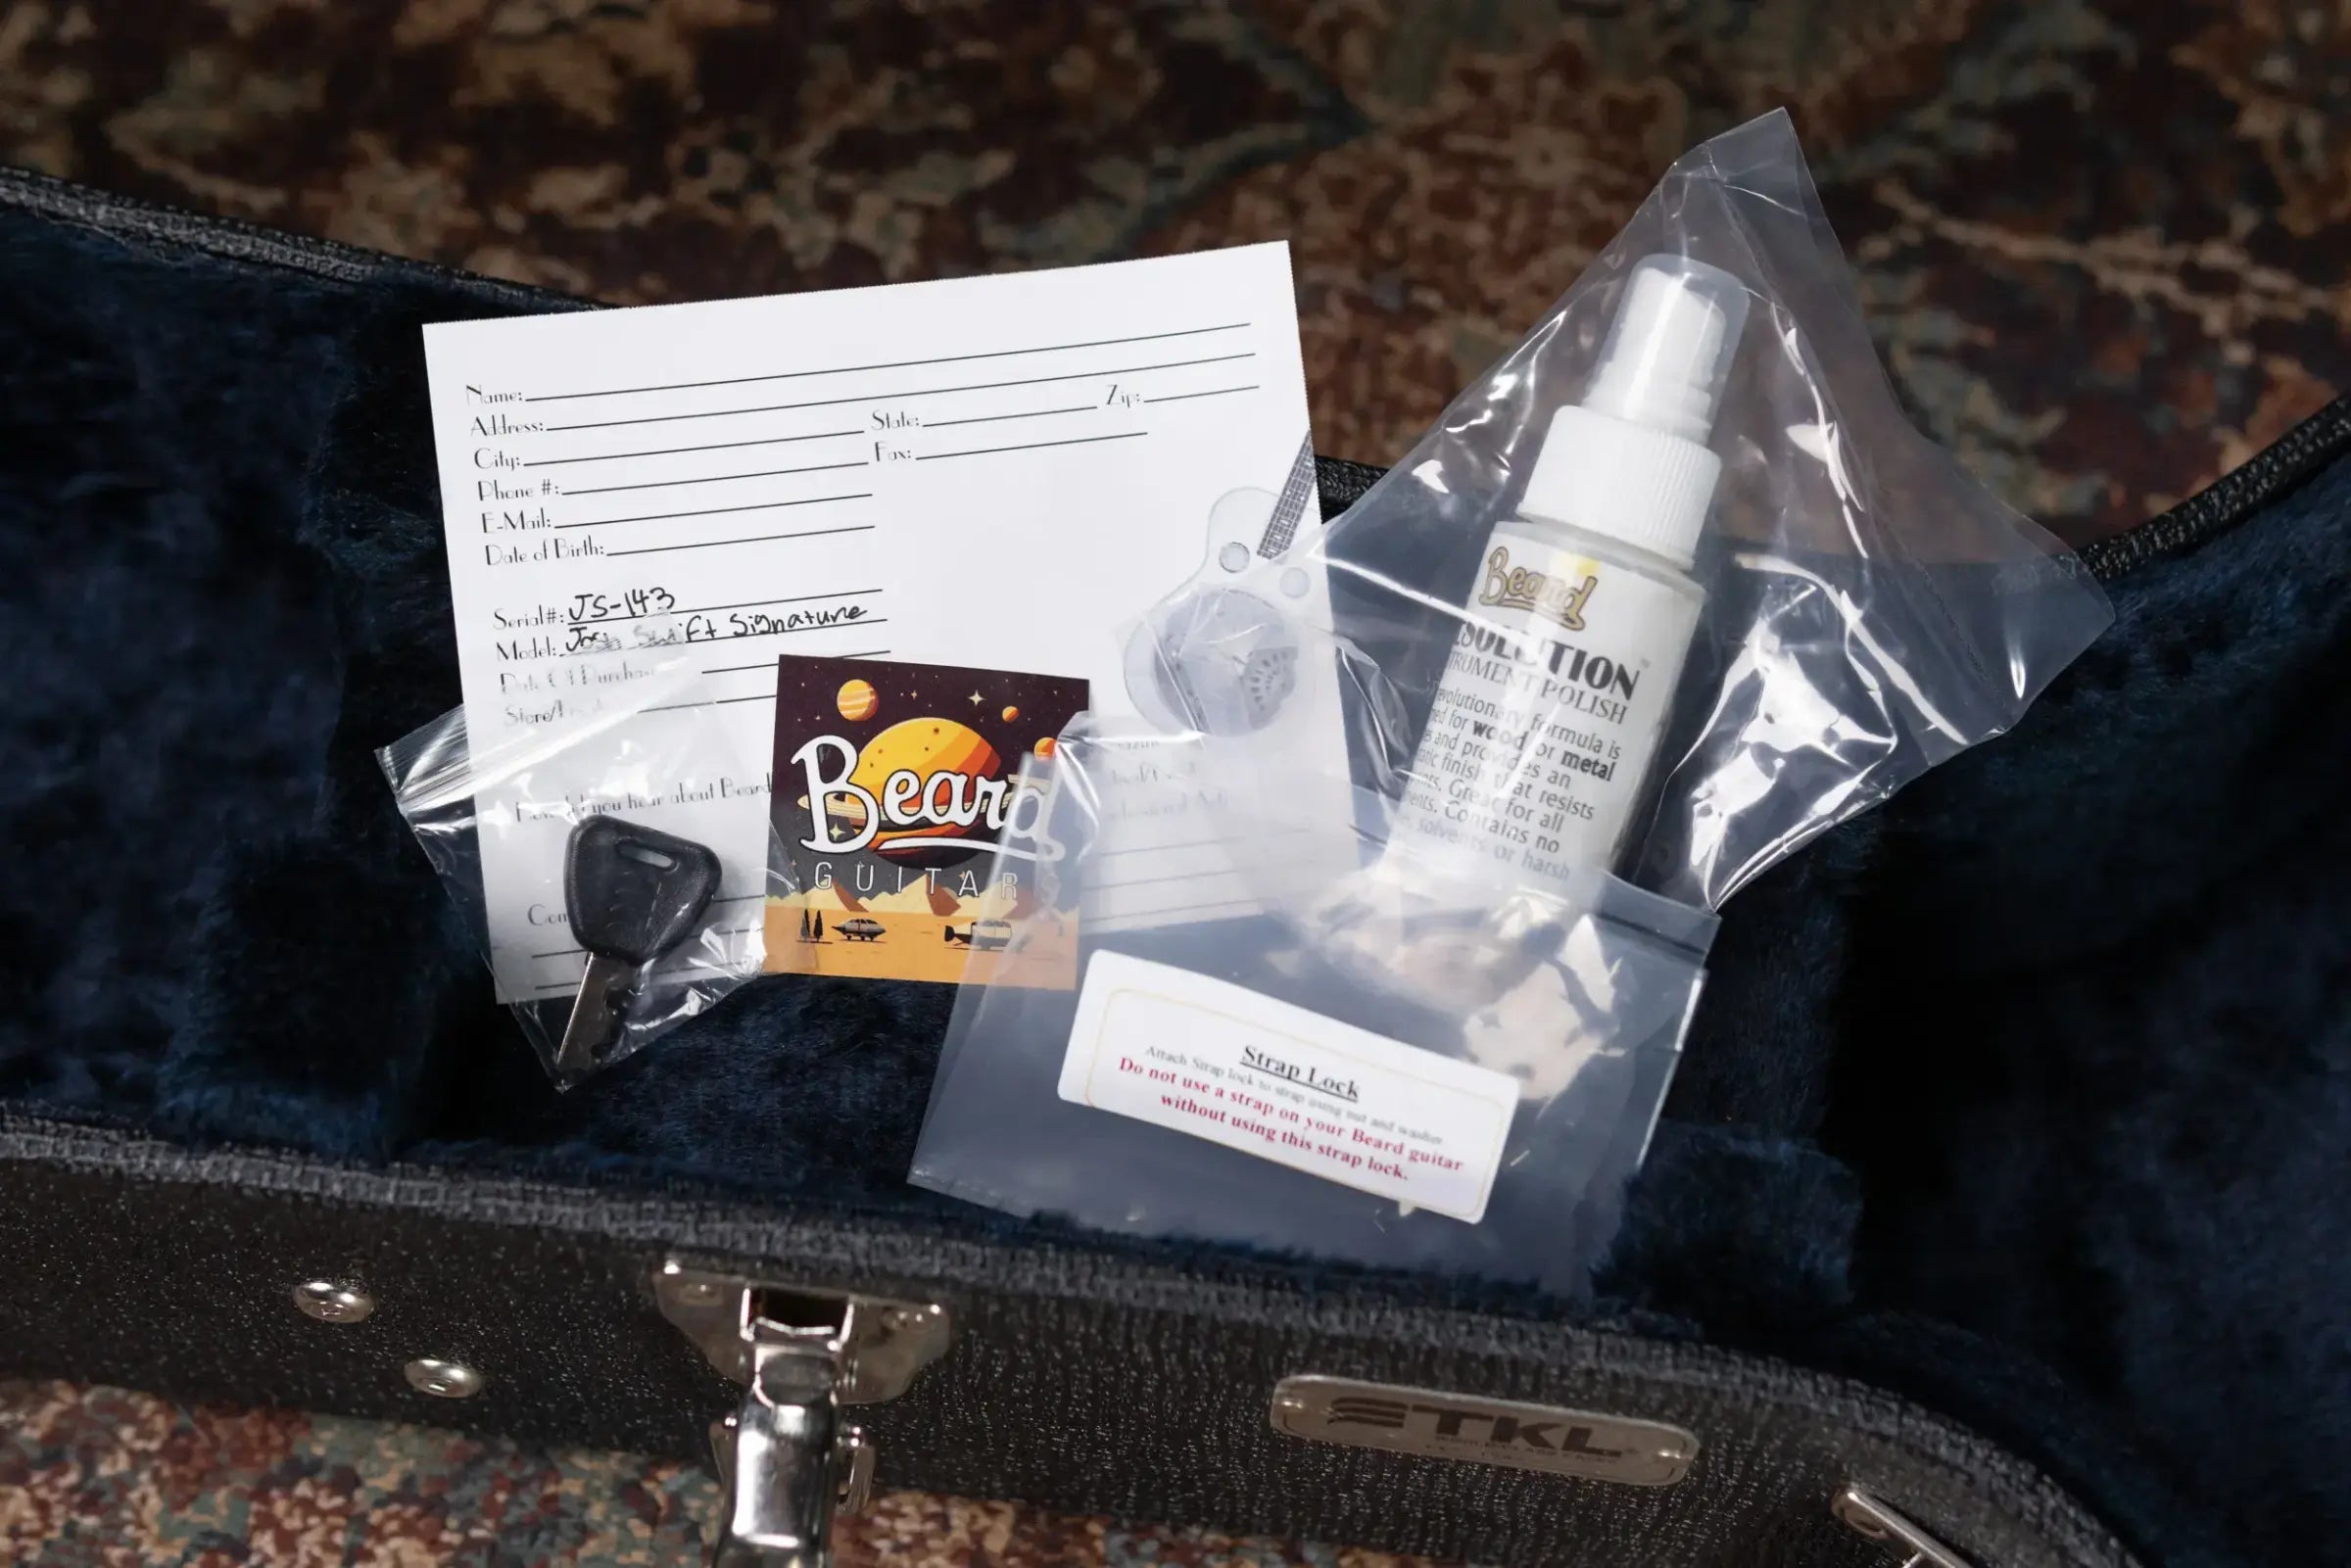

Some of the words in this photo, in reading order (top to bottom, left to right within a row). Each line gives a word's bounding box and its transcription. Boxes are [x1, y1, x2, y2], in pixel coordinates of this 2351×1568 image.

[465, 384, 524, 406] Name:
[469, 414, 545, 438] Address:
[473, 449, 521, 472] City:
[871, 410, 921, 432] State:
[1106, 384, 1141, 408] Zip:
[477, 480, 535, 503] Phone
[541, 479, 560, 496] #:
[874, 441, 912, 462] Fax:
[480, 507, 552, 535] E-Mail:
[485, 544, 528, 567] Date
[533, 539, 549, 562] of
[553, 535, 604, 561] Birth:
[568, 586, 676, 622] JS-143
[1478, 546, 1599, 632] Beard
[493, 603, 565, 631] Serial#:
[732, 603, 868, 639] Signature
[496, 635, 557, 662] Model:
[1541, 678, 1629, 725] POLISH
[1449, 708, 1469, 731] for
[1472, 719, 1529, 750] wood
[1560, 750, 1616, 783] metal
[1530, 713, 1604, 755] formula
[1607, 741, 1622, 761] is
[1433, 732, 1461, 751] and
[1547, 769, 1572, 790] an
[671, 781, 715, 806] about
[790, 734, 1067, 863] Beard
[1506, 798, 1536, 824] for
[1540, 812, 1565, 834] all
[1539, 789, 1595, 822] resists
[1445, 799, 1530, 845] Contains
[1535, 833, 1560, 855] no
[1520, 849, 1571, 880] harsh
[1145, 1045, 1188, 1068] Attach
[1192, 1056, 1225, 1078] Strap
[1227, 1067, 1255, 1086] lock
[1259, 1078, 1272, 1091] to
[1274, 1085, 1306, 1105] strap
[1369, 1117, 1396, 1132] and
[1241, 1043, 1302, 1081] Strap
[1308, 1065, 1362, 1099] Lock
[1118, 1056, 1145, 1074] Do
[1147, 1066, 1178, 1085] not
[1181, 1075, 1212, 1095] use
[1214, 1086, 1225, 1099] a
[1228, 1089, 1275, 1117] strap
[1278, 1107, 1300, 1123] on
[1304, 1116, 1347, 1138] your
[1351, 1127, 1406, 1156] Beard
[1408, 1147, 1465, 1171] guitar
[1159, 1093, 1227, 1123] without
[1229, 1116, 1277, 1143] using
[1280, 1128, 1313, 1152] this
[1315, 1143, 1364, 1169] strap
[1367, 1156, 1410, 1181] lock.
[1411, 1403, 1623, 1458] TKL
